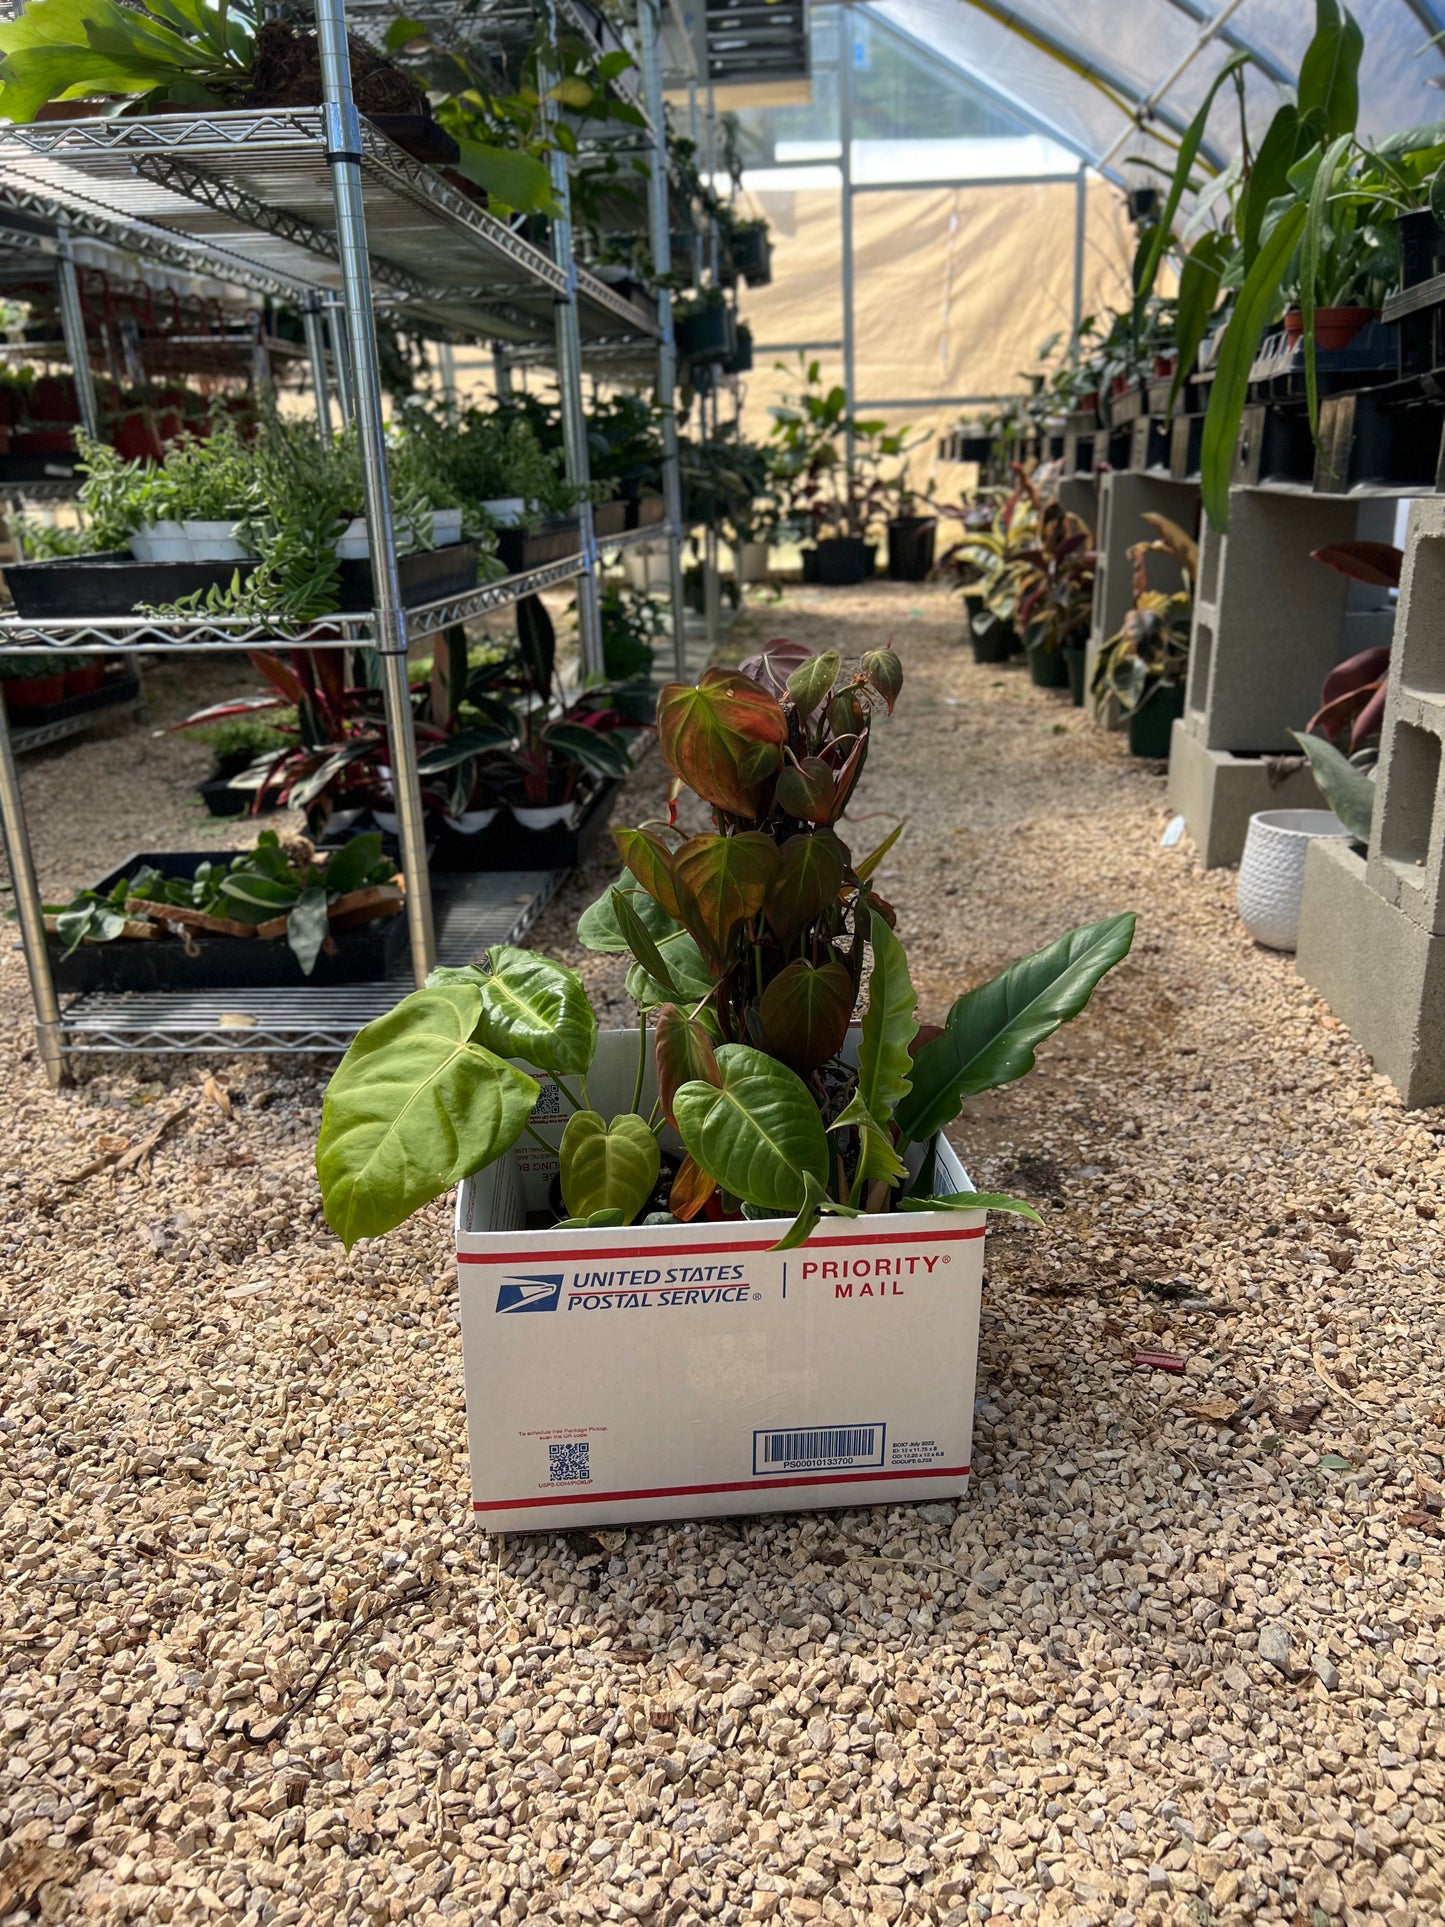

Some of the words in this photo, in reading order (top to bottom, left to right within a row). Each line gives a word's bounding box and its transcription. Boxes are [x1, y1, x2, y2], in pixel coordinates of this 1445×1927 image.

[533, 1161, 558, 1171] LING
[573, 1268, 661, 1288] UNITED
[664, 1265, 745, 1284] STATES
[835, 1281, 904, 1299] MAIL
[567, 1292, 653, 1311] POSTAL
[783, 1457, 854, 1469] PS00010133700
